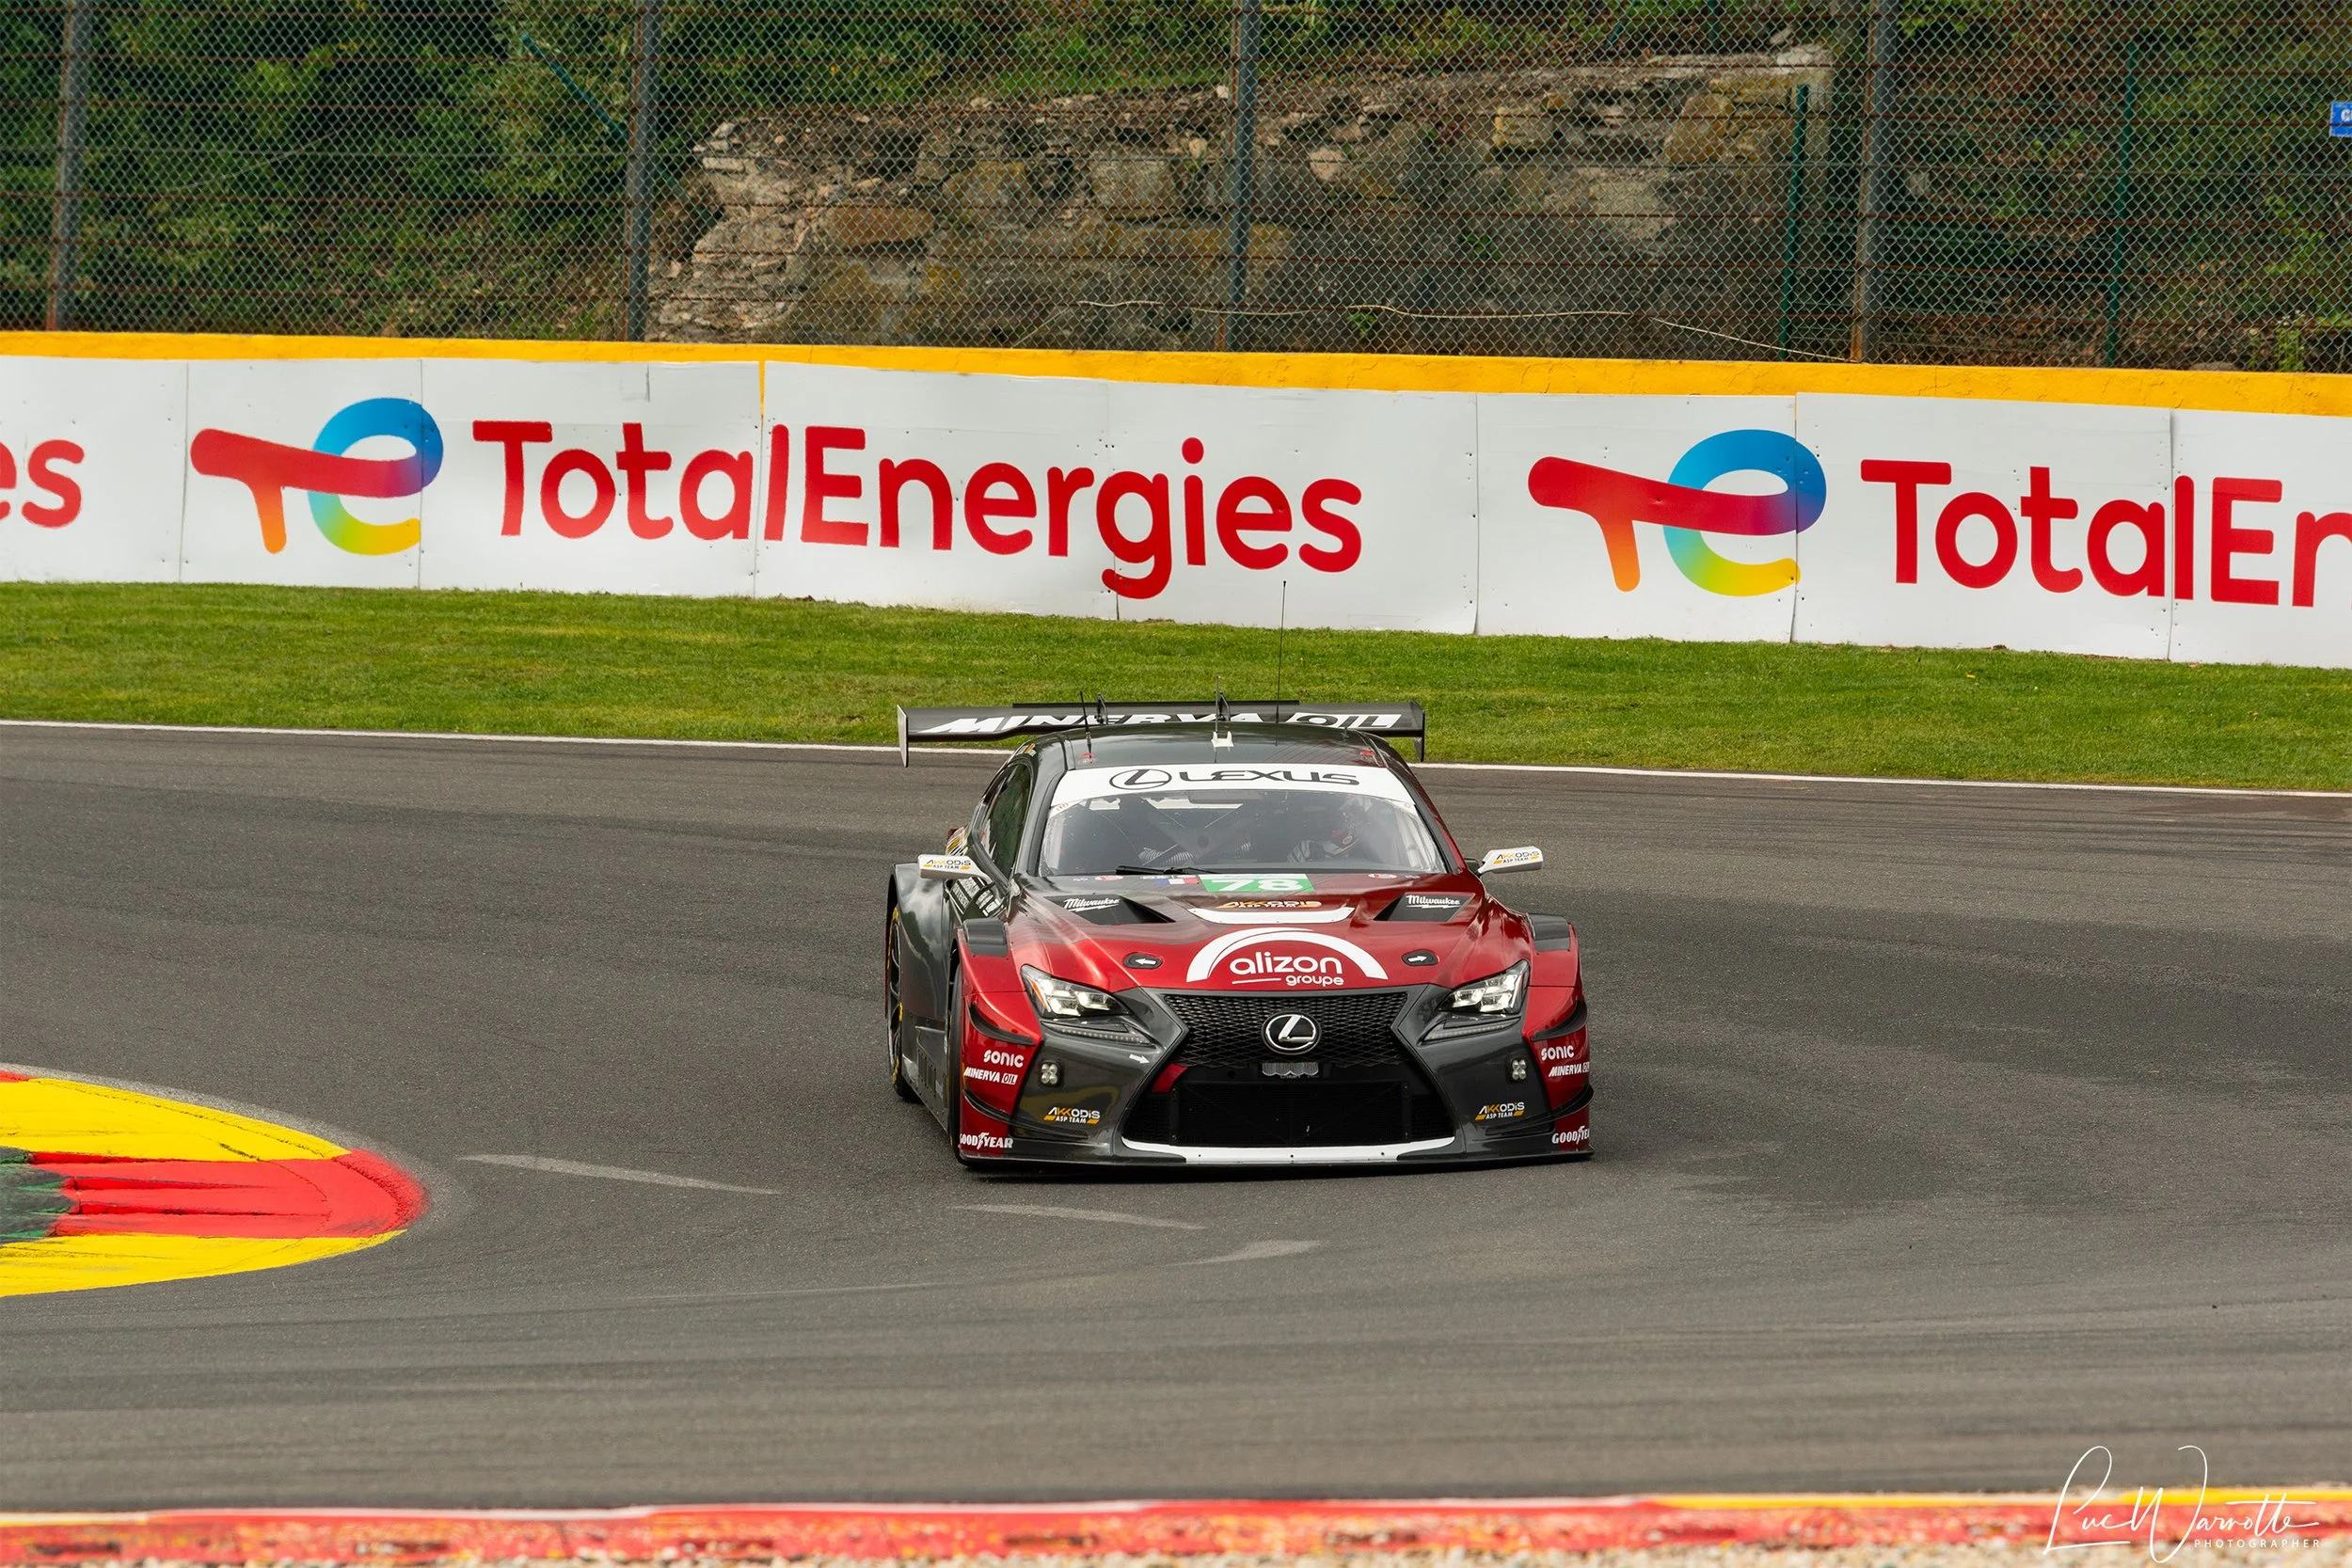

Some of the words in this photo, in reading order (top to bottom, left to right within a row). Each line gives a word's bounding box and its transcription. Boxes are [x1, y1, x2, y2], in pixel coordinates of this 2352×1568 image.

[0, 439, 85, 529] s
[472, 420, 1362, 600] TotalEnergies
[1860, 458, 2352, 608] TotalEn
[1292, 713, 1394, 729] OIL
[1179, 769, 1360, 786] LEXUS
[1211, 879, 1304, 892] 78
[1063, 897, 1121, 909] Milwaukee
[1406, 895, 1461, 906] Milwaukee
[1229, 951, 1343, 975] alizon
[1285, 974, 1344, 987] groupe
[963, 1066, 1000, 1083] MINERVA
[1001, 1072, 1018, 1085] OIL
[1548, 1063, 1582, 1077] MINERVA
